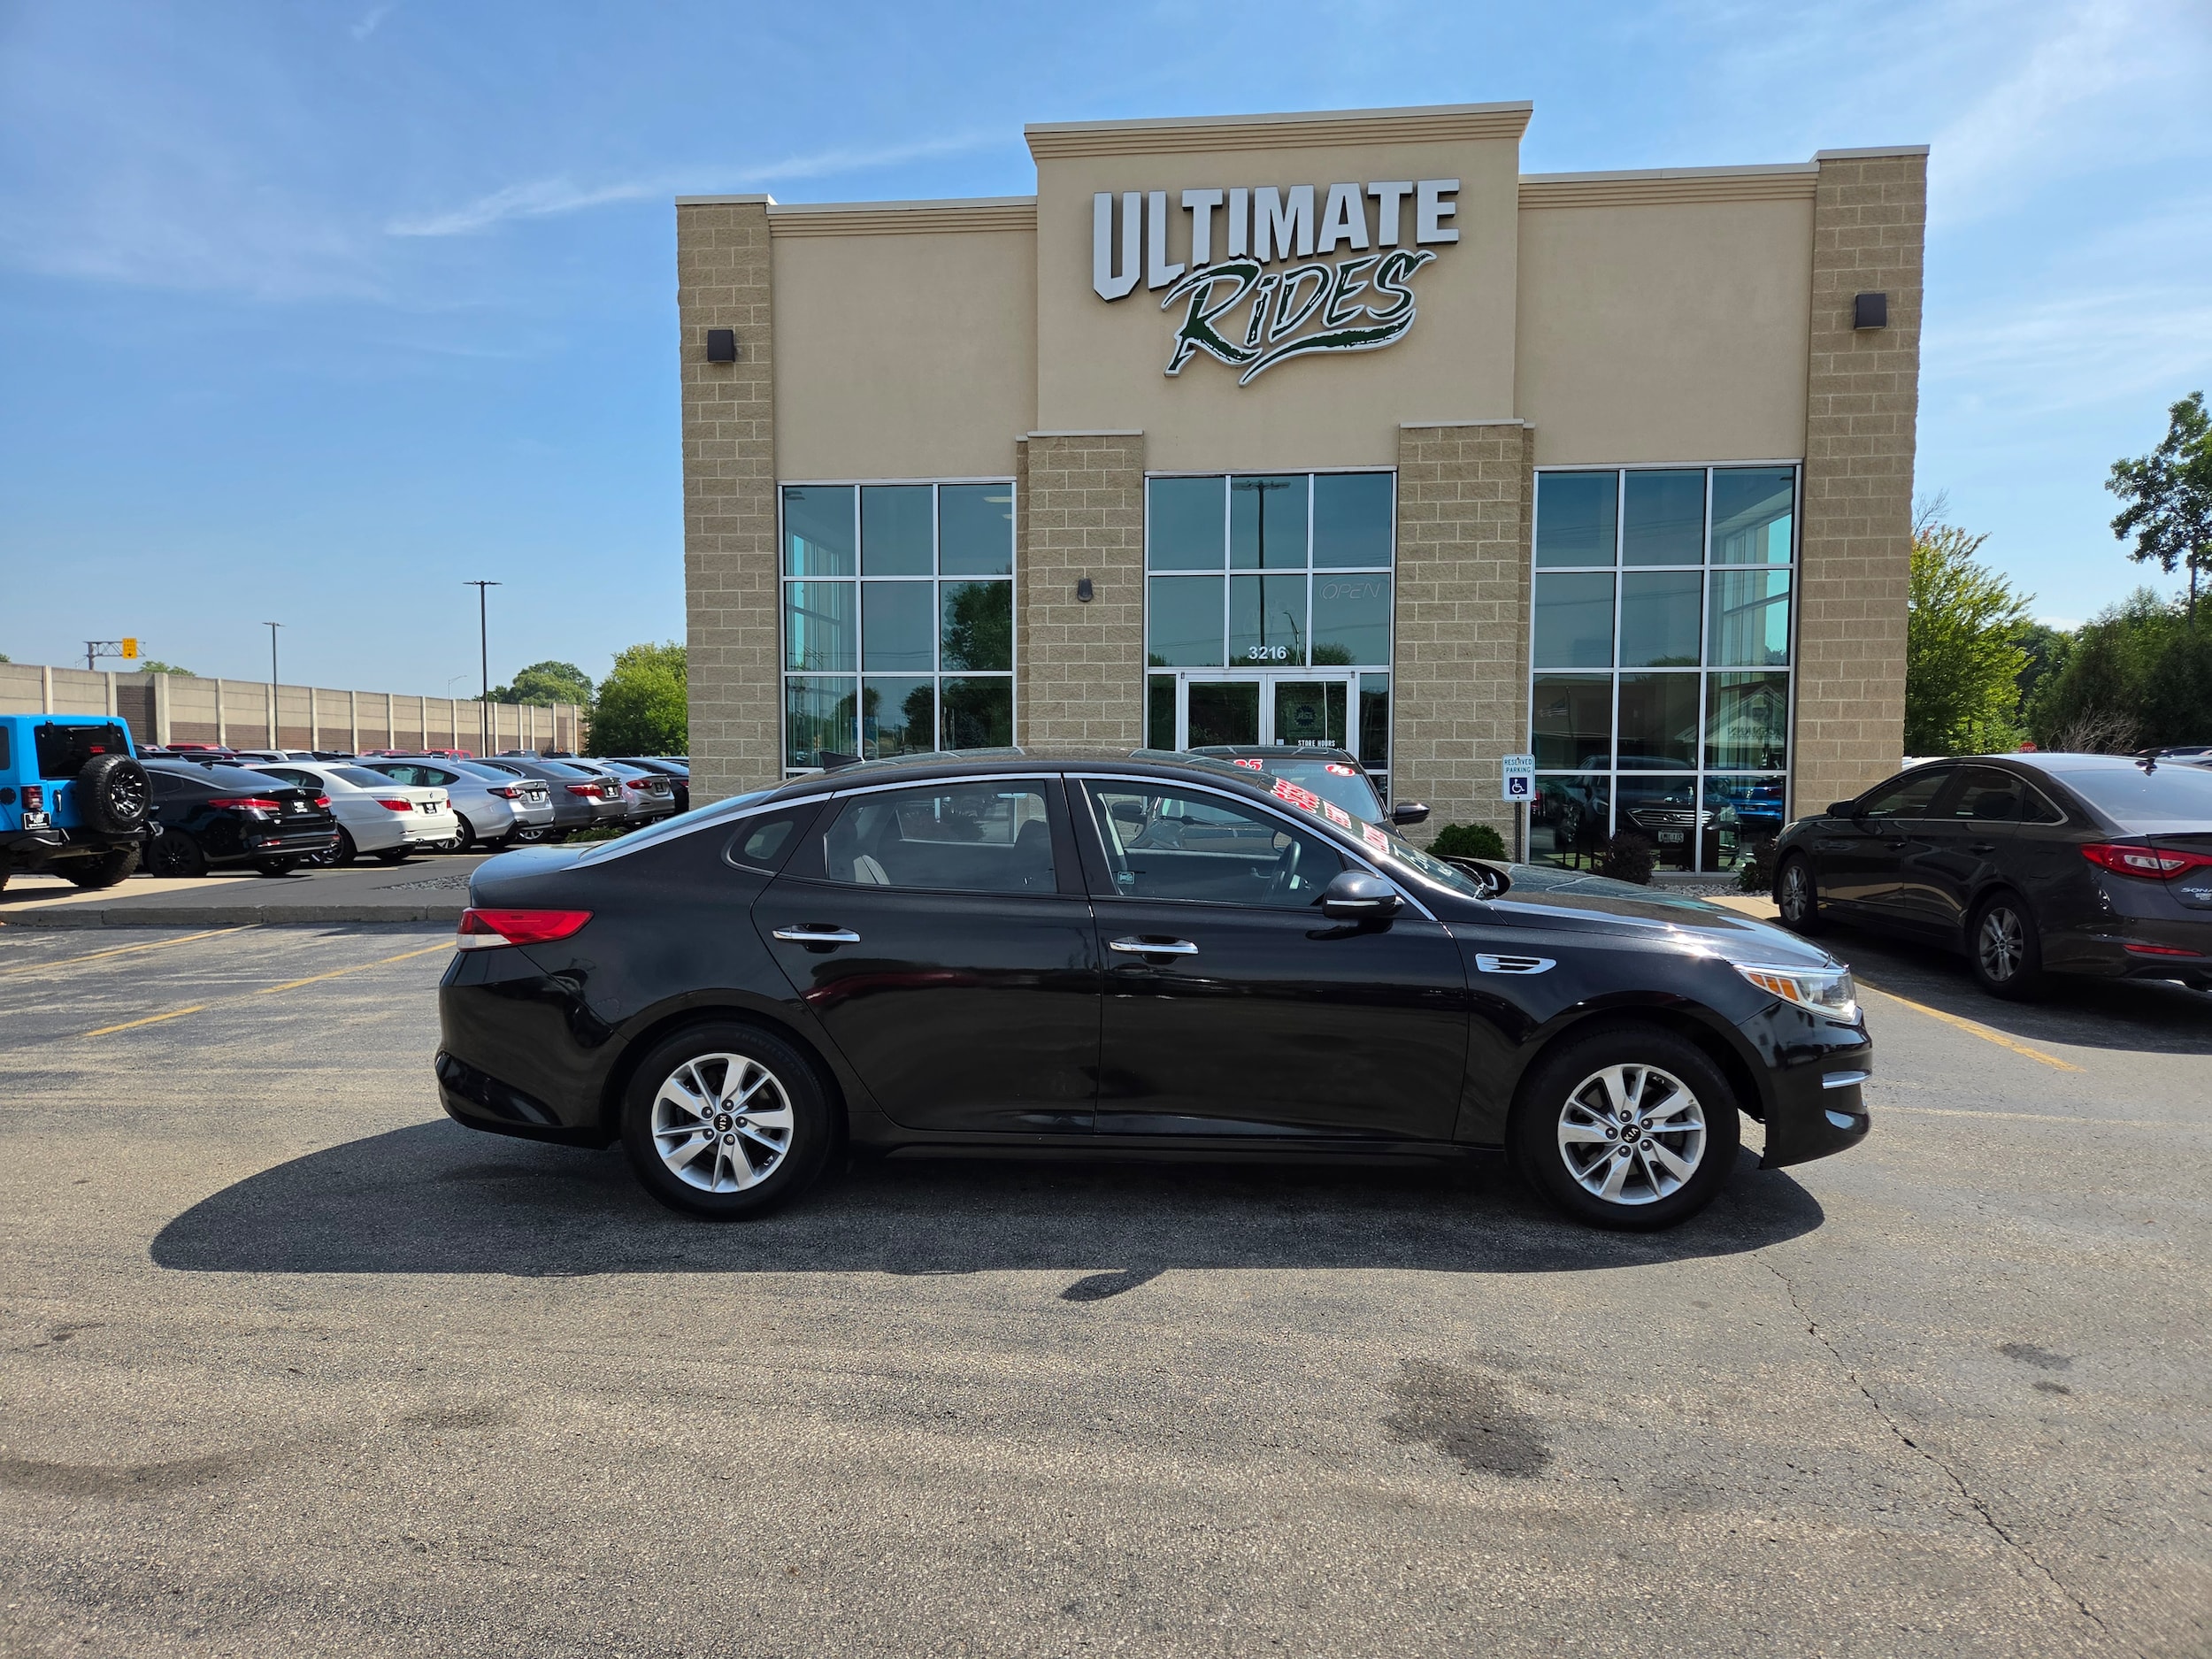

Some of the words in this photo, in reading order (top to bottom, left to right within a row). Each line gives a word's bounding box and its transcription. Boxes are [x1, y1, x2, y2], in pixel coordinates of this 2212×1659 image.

[1093, 178, 1460, 303] ULTIMATE
[1321, 582, 1380, 599] OPEN
[1248, 645, 1287, 660] 3216
[1623, 1127, 1640, 1142] KIA
